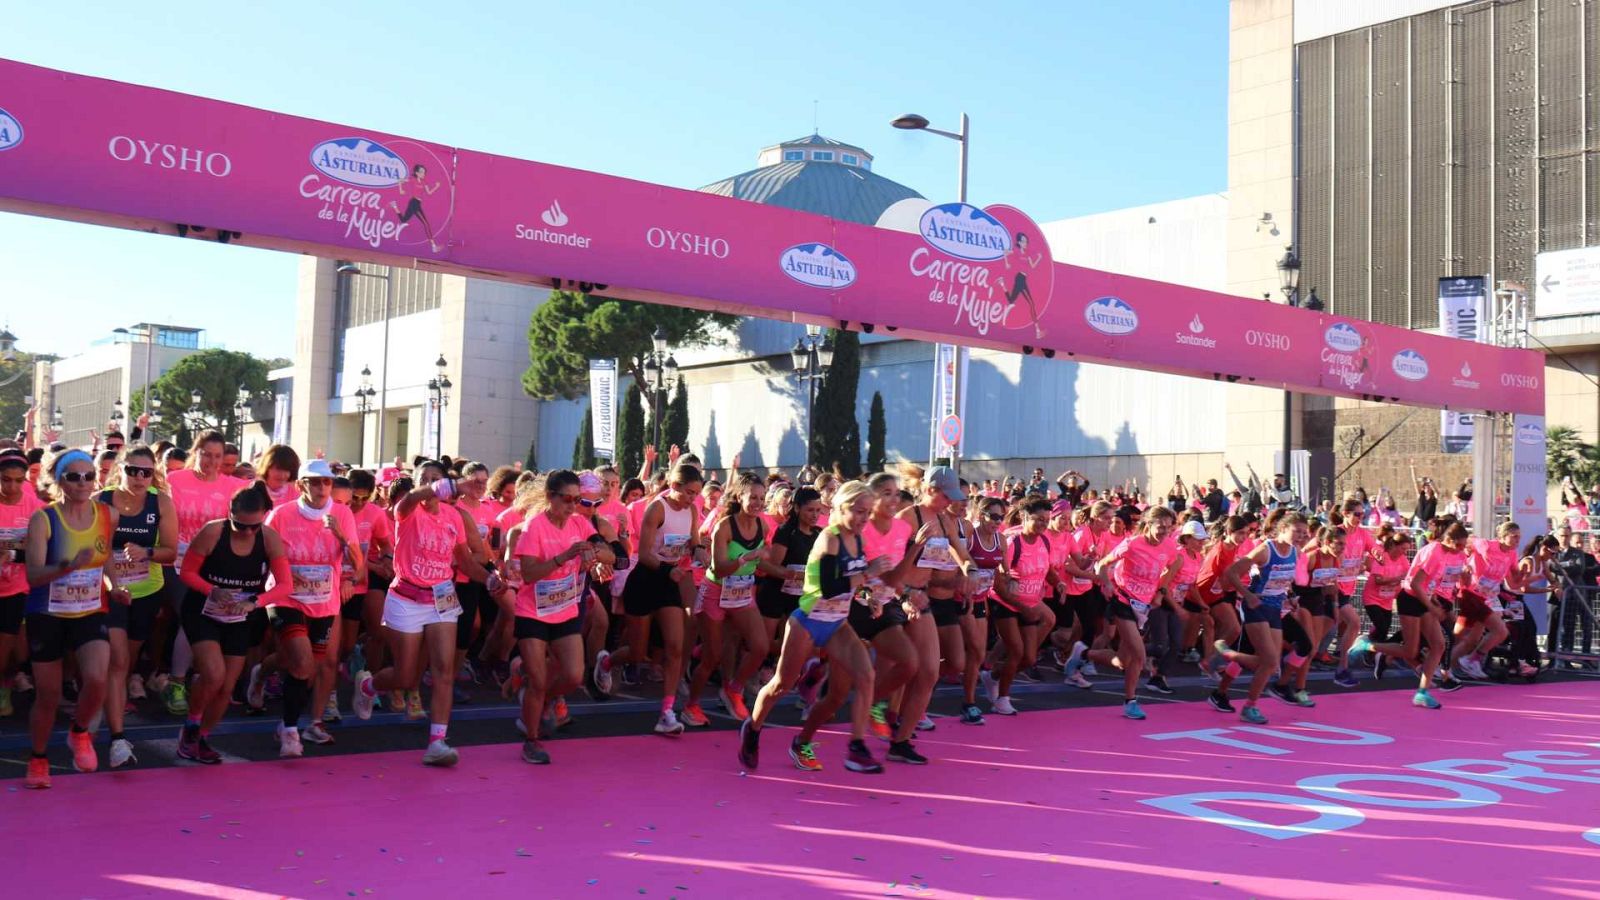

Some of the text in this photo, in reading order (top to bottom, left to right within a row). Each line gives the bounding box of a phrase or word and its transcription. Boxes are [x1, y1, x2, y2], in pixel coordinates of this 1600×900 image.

[108, 135, 232, 177] OYSHO
[319, 149, 400, 179] ASTURIANA
[299, 174, 382, 209] Carrera
[318, 205, 408, 248] de la Mujer
[515, 223, 591, 249] Santander
[926, 216, 1004, 251] ASTURIANA
[646, 227, 730, 258] OYSHO
[786, 254, 850, 281] ASTURIANA
[909, 248, 991, 289] Carrera
[929, 282, 1016, 335] de la Mujer
[1089, 309, 1135, 327] ASTURIANA
[1176, 332, 1217, 349] Santander
[1245, 329, 1291, 351] OYSHO
[1501, 373, 1539, 390] OYSHO
[67, 587, 89, 595] 016
[548, 591, 567, 601] 016
[1141, 722, 1395, 755] TU
[1136, 748, 1600, 841] DORS
